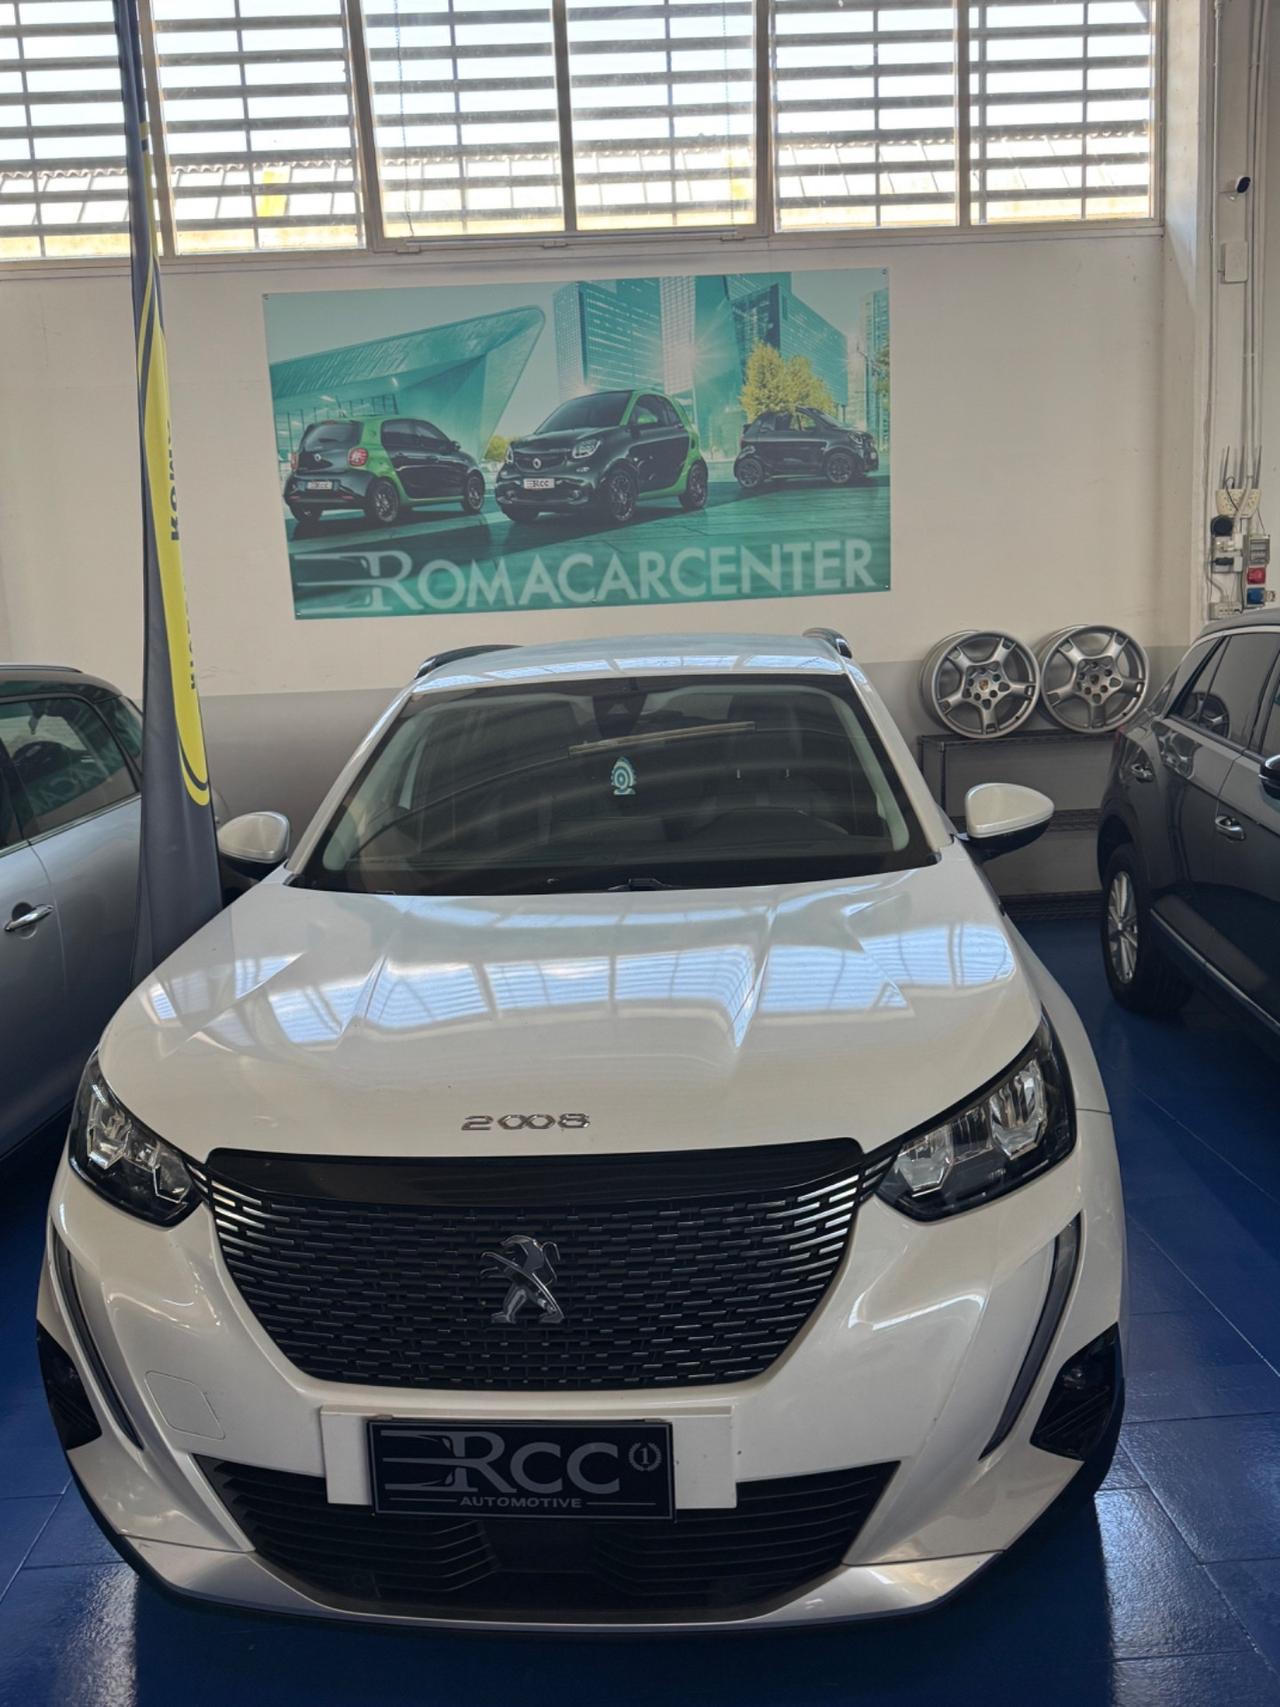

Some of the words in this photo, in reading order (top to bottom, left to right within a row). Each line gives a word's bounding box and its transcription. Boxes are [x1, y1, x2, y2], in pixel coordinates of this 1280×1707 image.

[365, 538, 877, 613] ROMACARCENTER
[460, 1112, 592, 1132] 2008
[448, 1430, 621, 1495] RCC
[459, 1496, 583, 1508] AUTOMOTIVE
